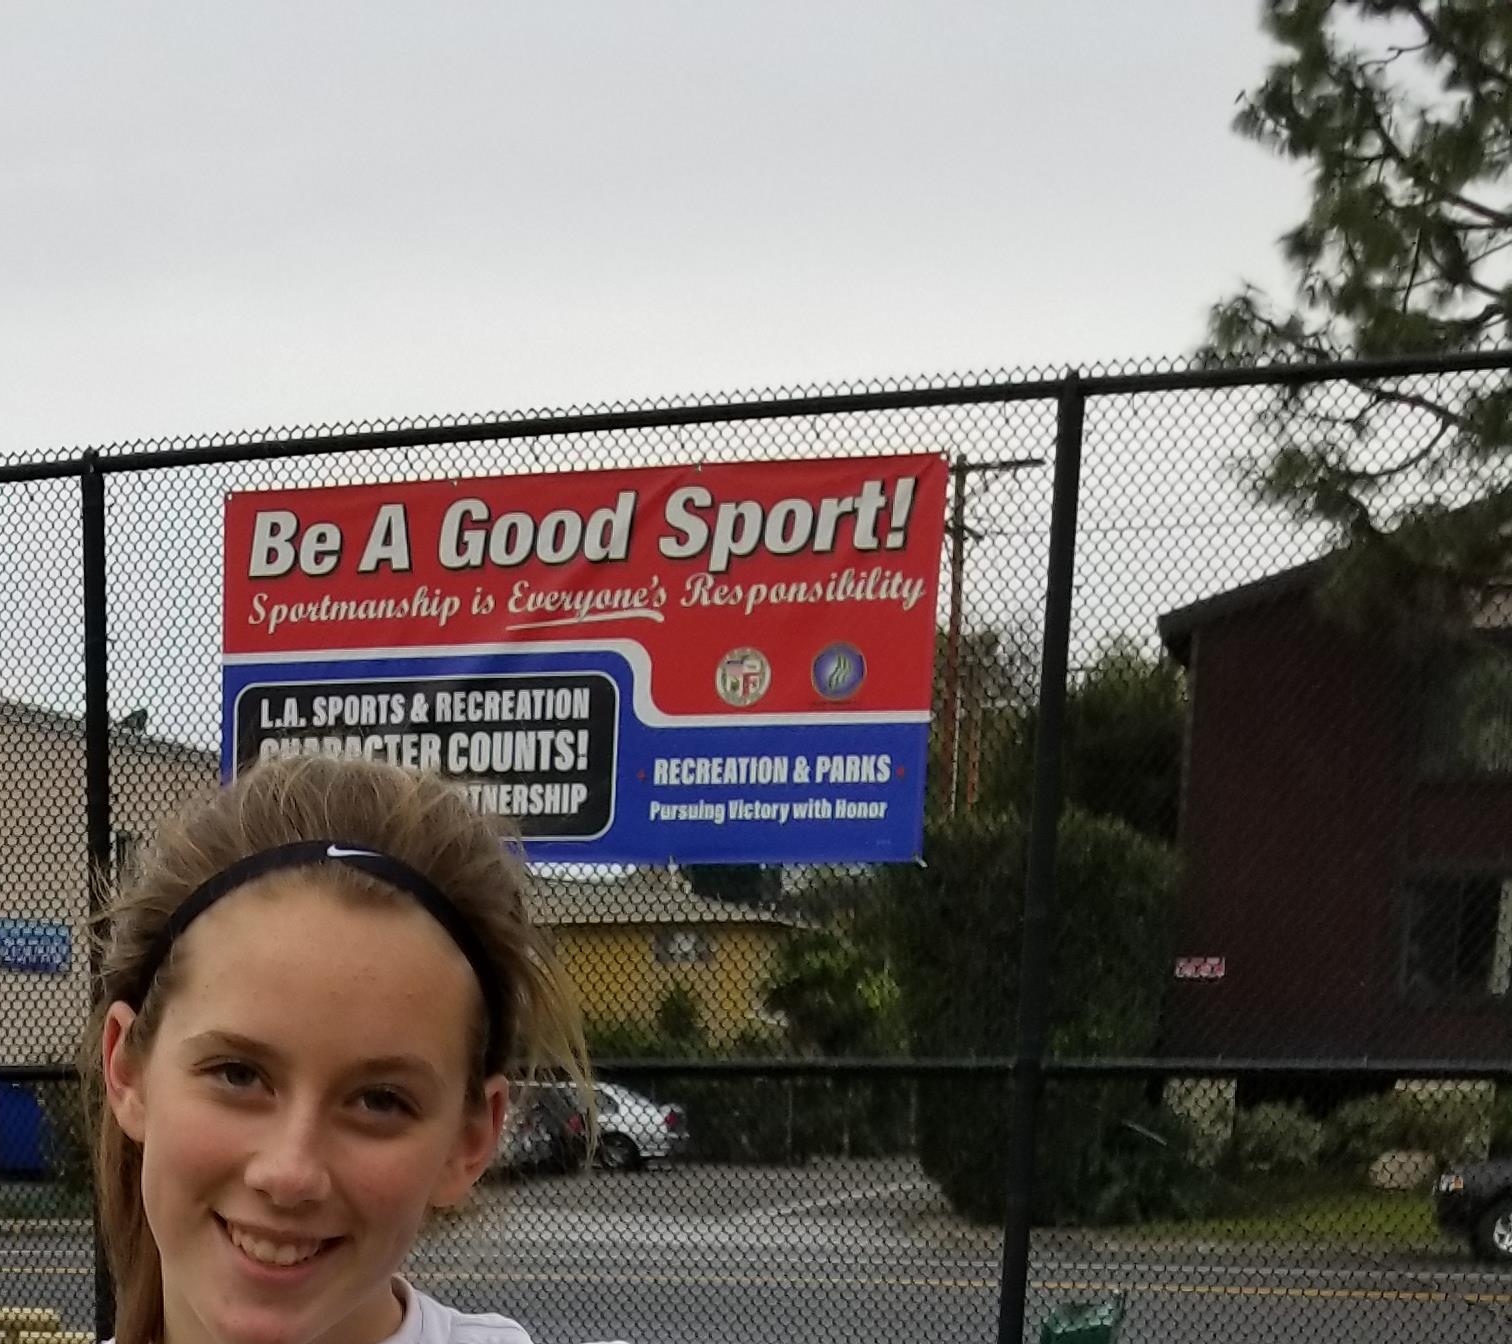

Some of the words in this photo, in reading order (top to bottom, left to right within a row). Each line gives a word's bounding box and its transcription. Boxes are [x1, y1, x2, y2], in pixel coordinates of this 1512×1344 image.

[248, 510, 343, 579] Be
[357, 503, 411, 574] A
[438, 490, 637, 570] Good
[658, 477, 917, 573] Sport!
[248, 586, 461, 634] Sportmanship
[471, 586, 495, 615] is
[507, 575, 668, 623] Everyone's
[681, 566, 925, 616] Responsibility
[260, 697, 306, 728] L.A.
[312, 693, 406, 727] SPORTS
[410, 692, 429, 724] &
[435, 688, 590, 722] RECREATION
[448, 729, 589, 773] COUNTS!
[653, 756, 788, 785] RECREATION
[793, 756, 810, 784] &
[815, 754, 892, 783] PARKS
[464, 783, 588, 815] TNERSHIP
[649, 800, 726, 825] Pursuing
[728, 799, 789, 825] Victory
[791, 798, 832, 820] with
[835, 798, 888, 819] Honor
